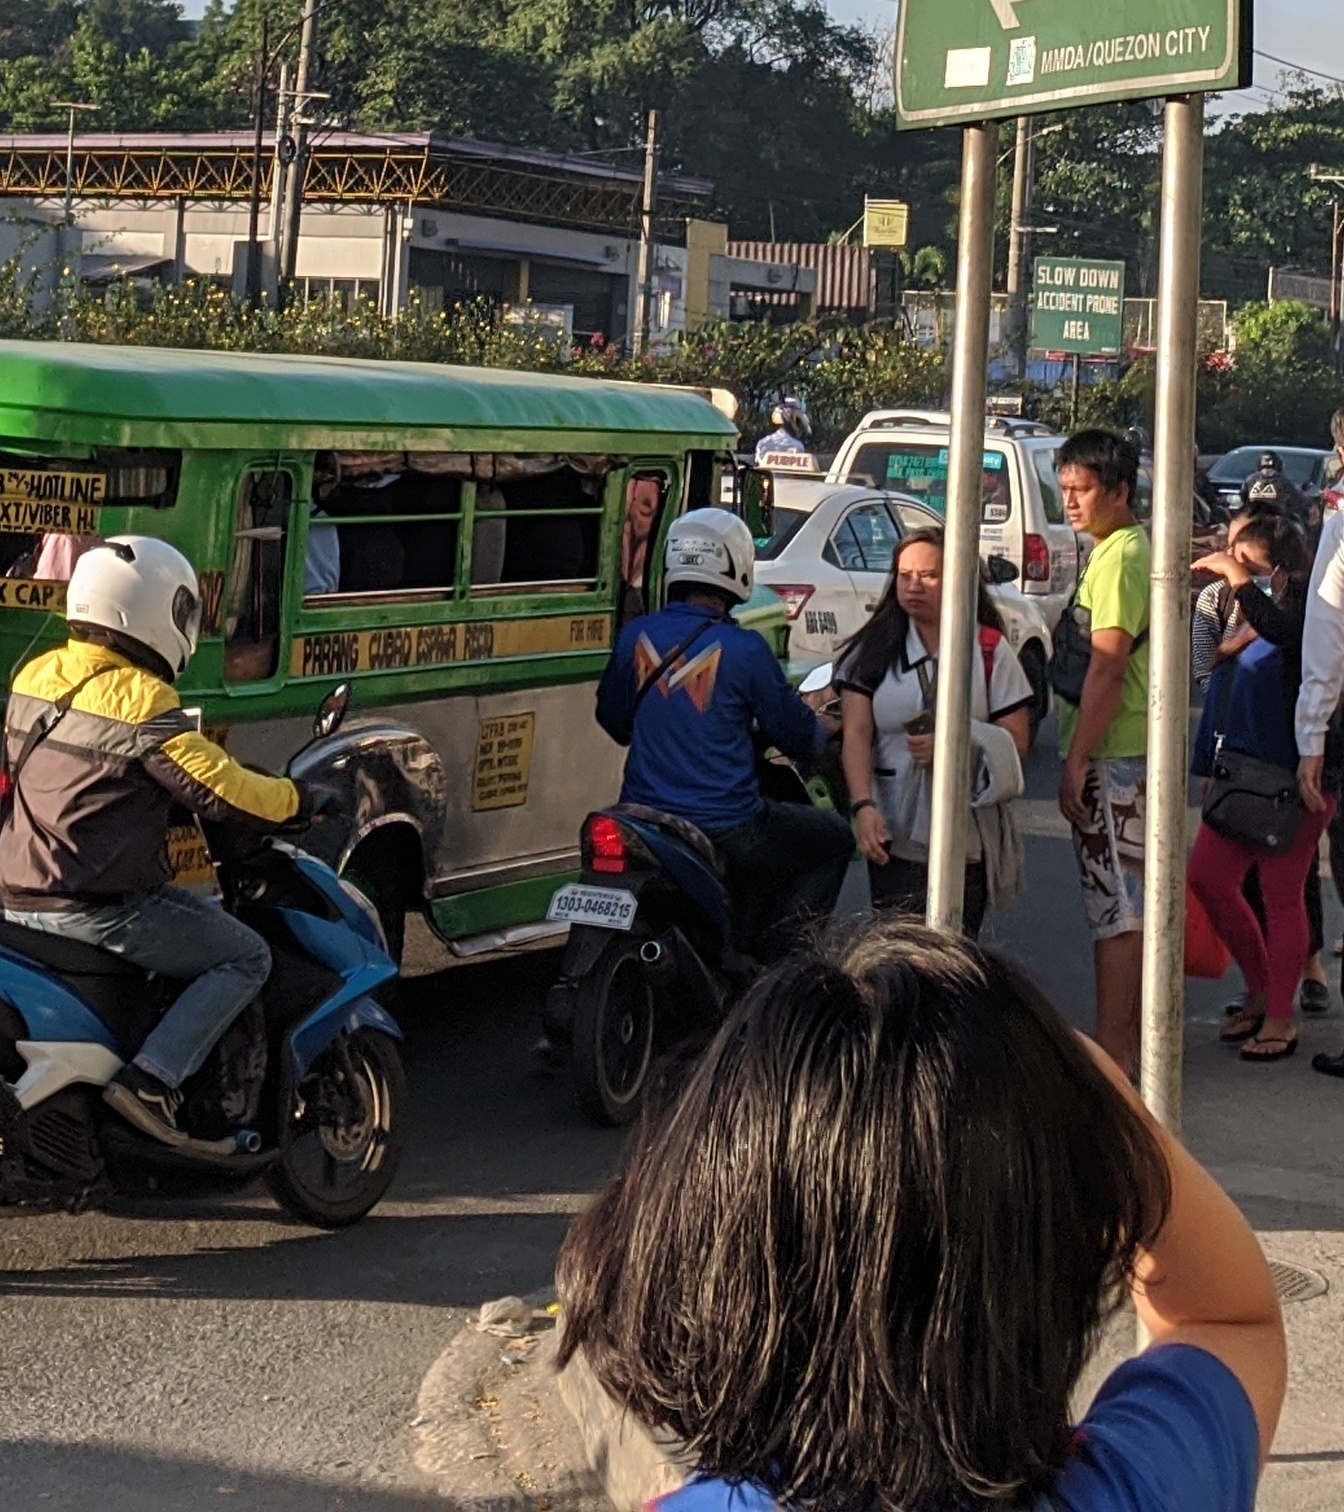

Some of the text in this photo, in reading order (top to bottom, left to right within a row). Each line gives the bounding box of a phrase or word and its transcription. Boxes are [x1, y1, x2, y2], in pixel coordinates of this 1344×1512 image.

[1041, 26, 1211, 74] MMDA/QUEZON CITY
[1037, 266, 1119, 289] SLOW DOWN
[1036, 292, 1118, 315] ACCIDENT PRONE
[1063, 320, 1090, 341] AREA
[767, 454, 809, 467] PURPLE
[28, 475, 101, 504] HOTLINE
[15, 584, 54, 605] CAP
[303, 634, 358, 676] PARANG
